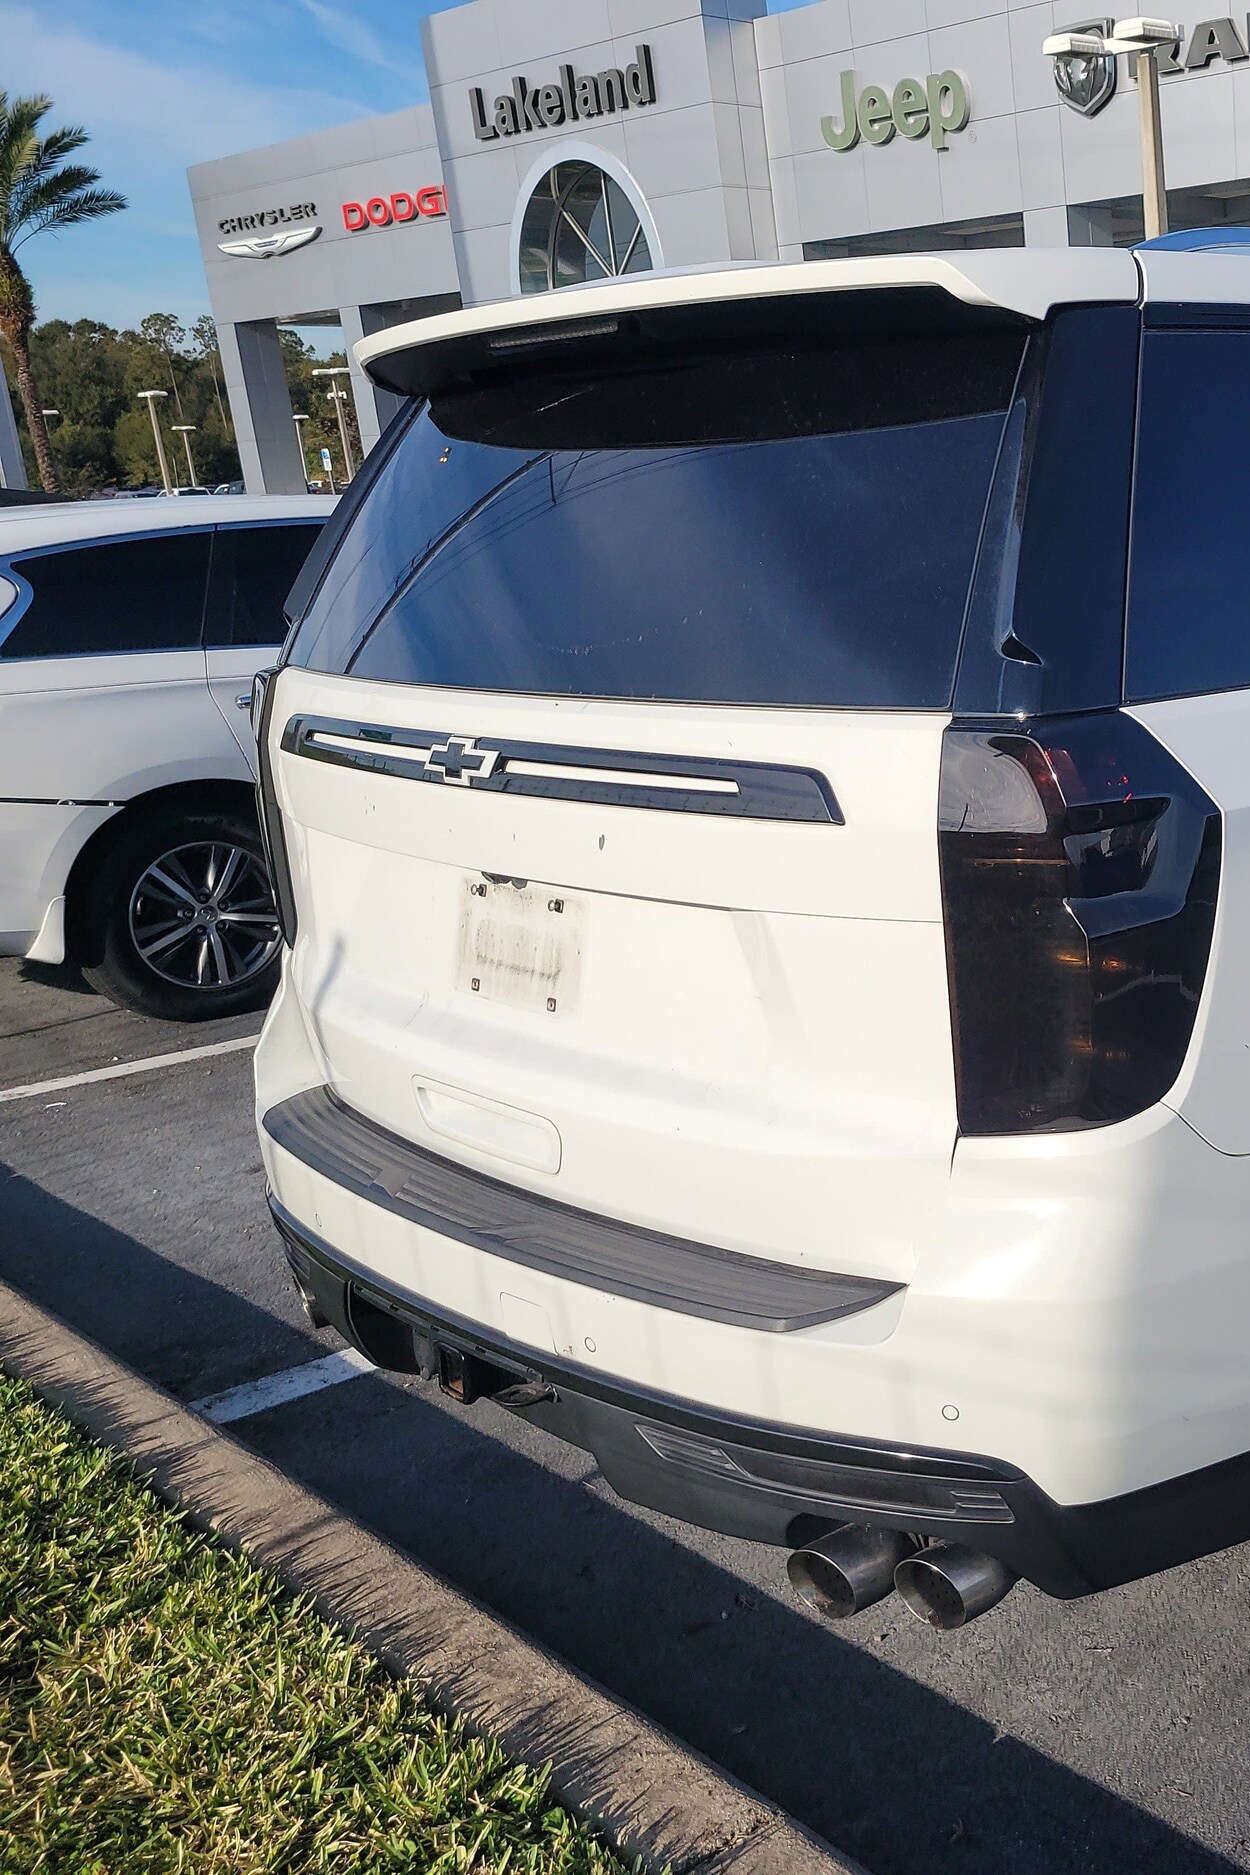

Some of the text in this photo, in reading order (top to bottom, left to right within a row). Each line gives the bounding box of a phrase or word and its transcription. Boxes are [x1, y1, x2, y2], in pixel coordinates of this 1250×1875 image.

[468, 44, 656, 141] Lakeland
[821, 70, 970, 151] Jeep
[218, 201, 318, 235] CHRYSLER
[341, 185, 448, 232] DODG
